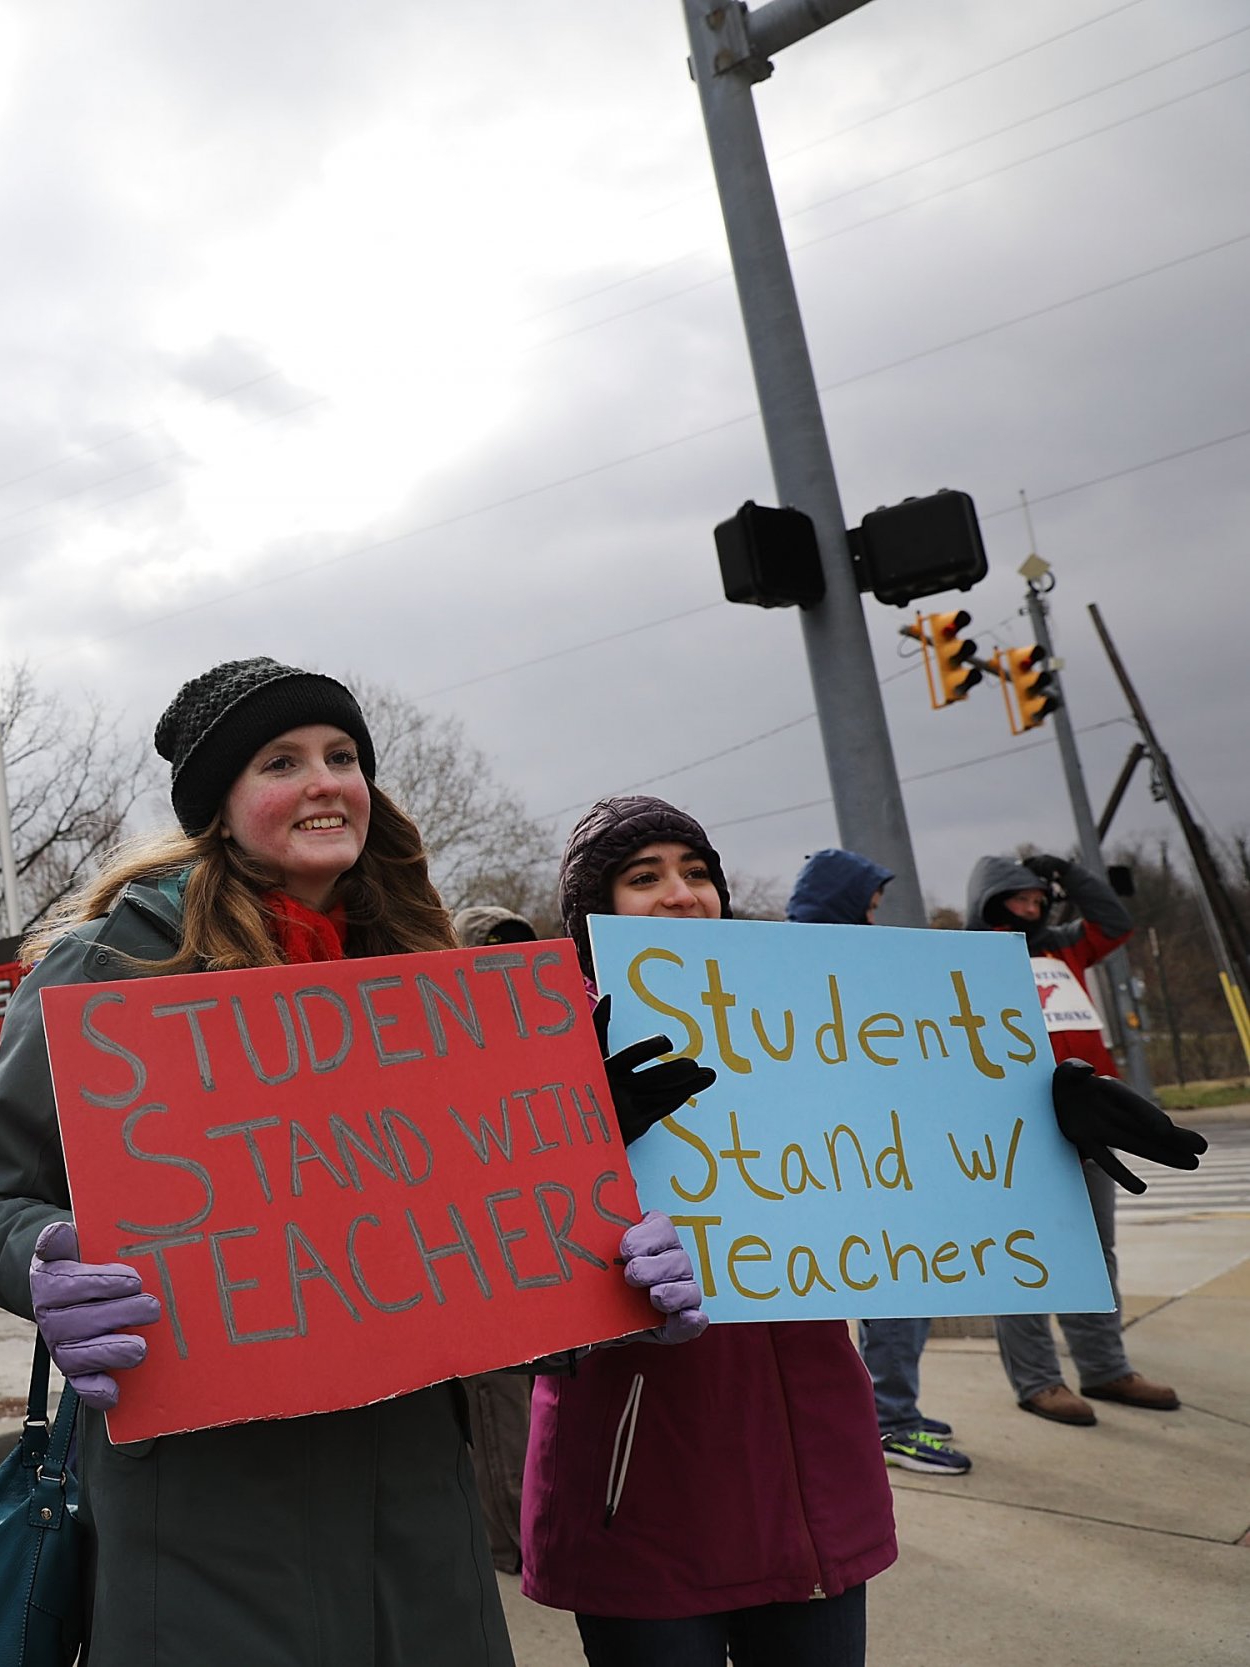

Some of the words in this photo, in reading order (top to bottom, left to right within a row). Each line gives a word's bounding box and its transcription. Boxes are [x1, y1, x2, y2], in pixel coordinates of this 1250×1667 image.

[78, 951, 578, 1110] STUDENTS
[626, 946, 1037, 1081] Students
[116, 1102, 435, 1236] STAND
[449, 1081, 614, 1165] WITH
[660, 1095, 914, 1204] Stand
[947, 1117, 1025, 1190] w/
[669, 1214, 1049, 1300] Teachers
